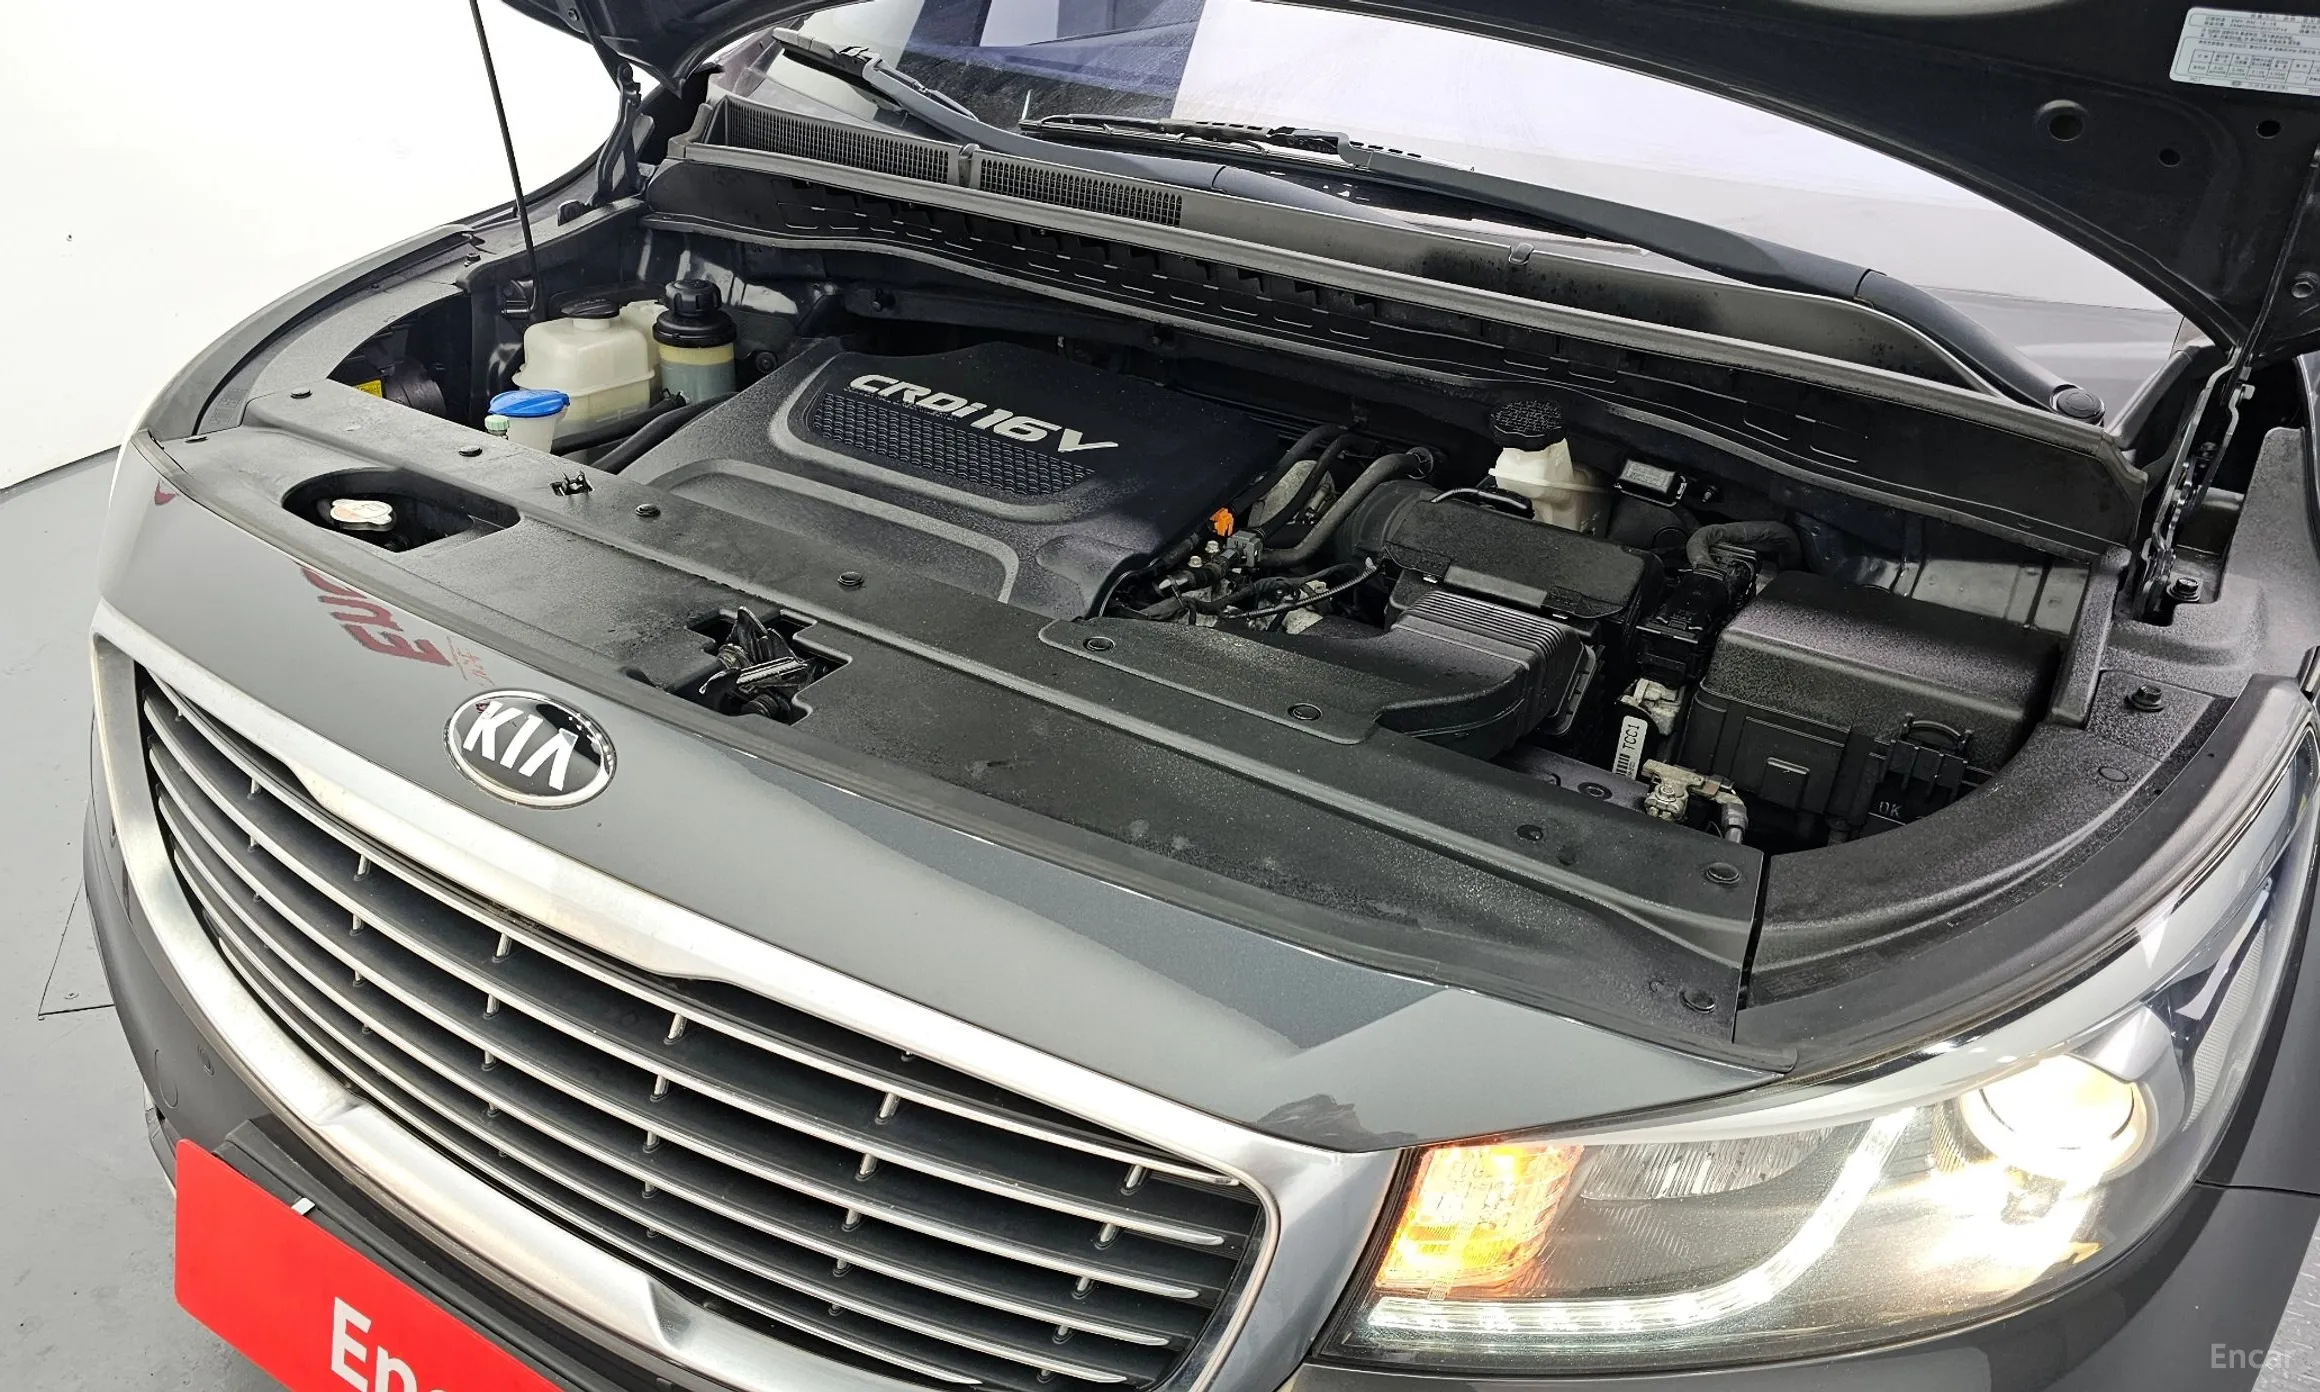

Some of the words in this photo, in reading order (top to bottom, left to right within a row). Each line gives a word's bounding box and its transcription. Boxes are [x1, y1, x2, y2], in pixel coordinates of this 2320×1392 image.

[850, 374, 988, 419] CRDi
[969, 408, 1119, 452] 16V
[462, 700, 579, 791] KIA
[331, 1296, 446, 1392] En
